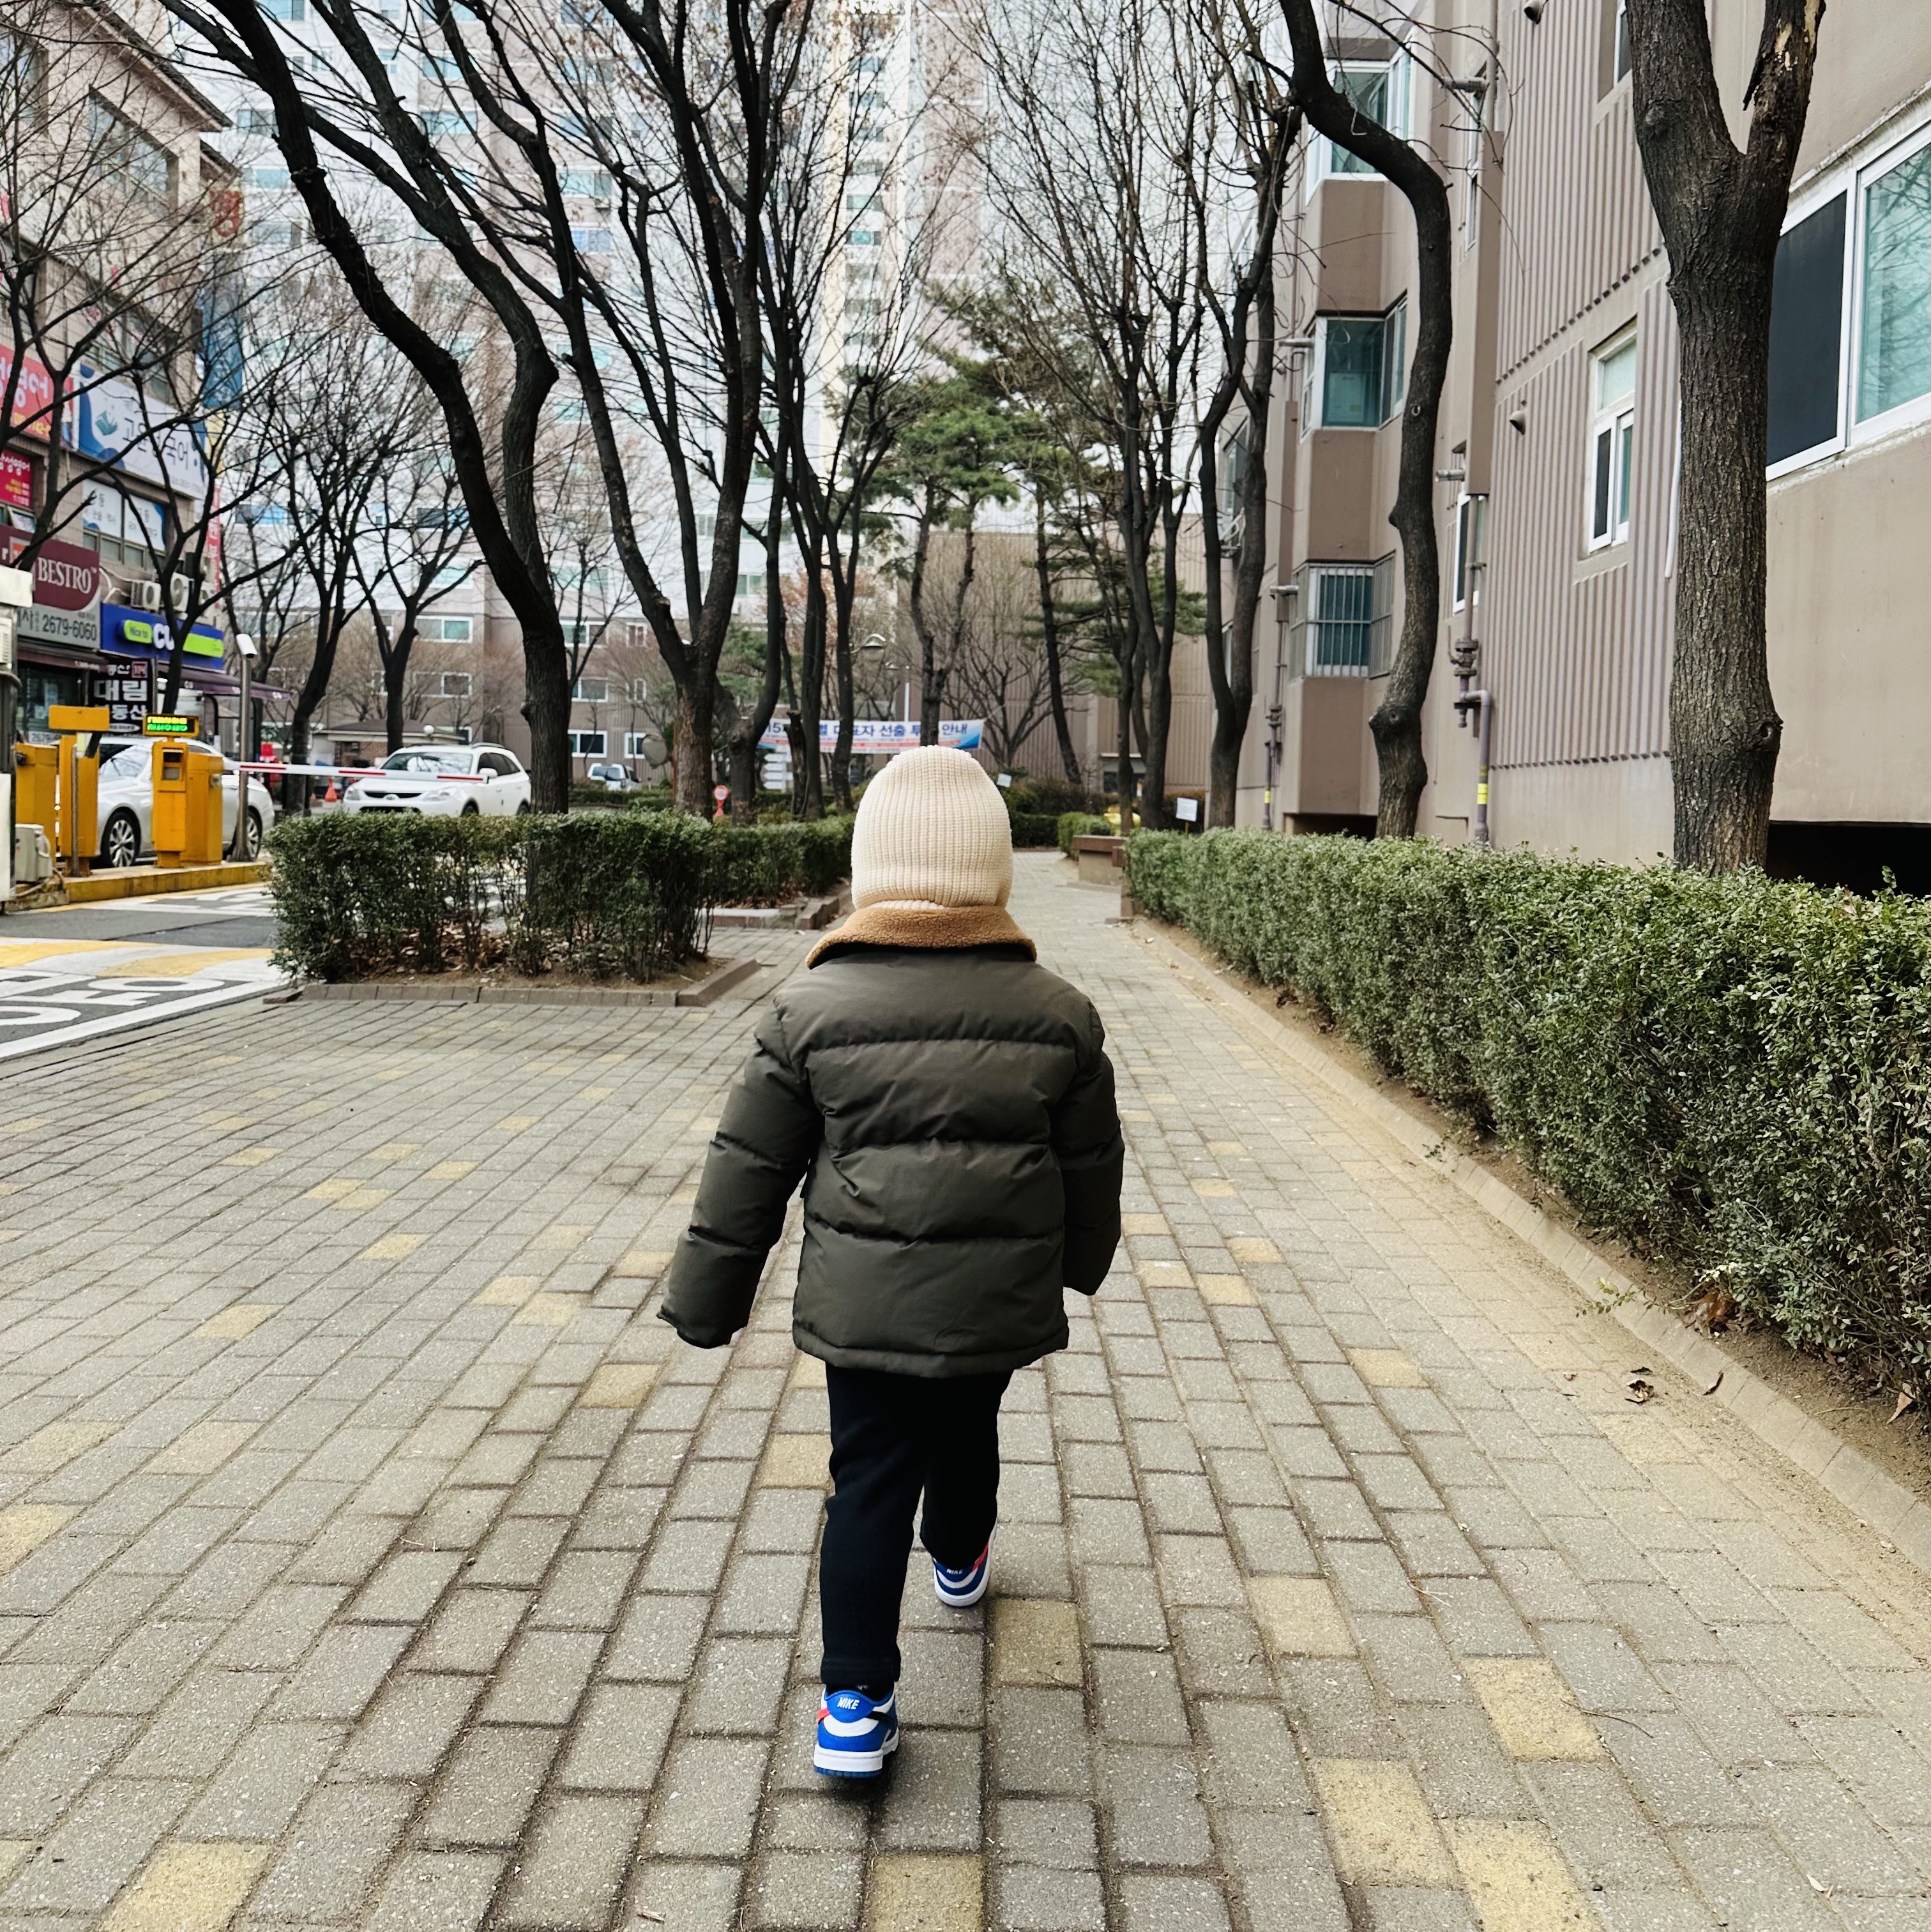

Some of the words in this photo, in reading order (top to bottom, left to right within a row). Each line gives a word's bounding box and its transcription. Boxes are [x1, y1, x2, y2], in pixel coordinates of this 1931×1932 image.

[38, 556, 92, 595] BESTRO
[94, 680, 148, 701] 대림
[880, 724, 905, 737] 선출
[942, 723, 967, 735] 안내
[837, 1696, 860, 1710] NIKE
